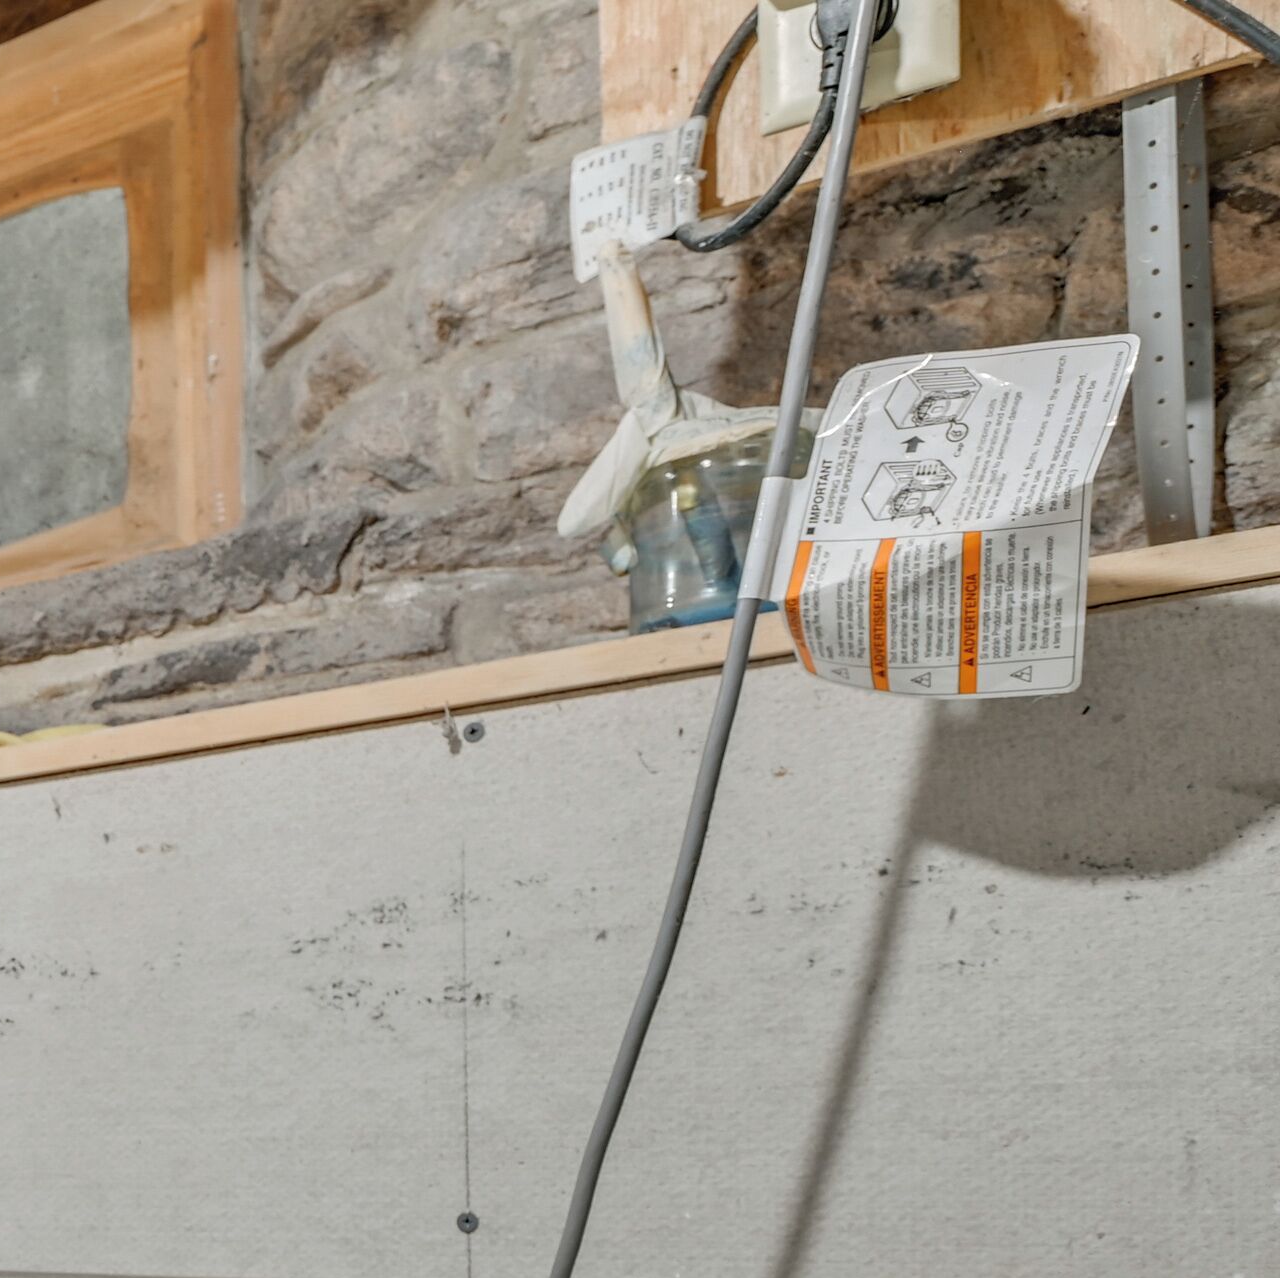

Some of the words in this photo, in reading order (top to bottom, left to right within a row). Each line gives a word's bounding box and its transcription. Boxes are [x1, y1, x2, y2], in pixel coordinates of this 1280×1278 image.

[1082, 391, 1093, 408] must
[1087, 381, 1096, 389] be
[994, 414, 1004, 426] and
[1017, 482, 1028, 493] the
[1034, 421, 1048, 446] braces
[1043, 404, 1054, 417] and
[1049, 388, 1060, 400] the
[1055, 355, 1067, 383] wrench
[1072, 411, 1087, 434] braces
[976, 421, 991, 452] shipping
[1067, 436, 1078, 448] and
[825, 480, 842, 517] SHIPPING
[841, 424, 853, 446] MUST
[1035, 476, 1051, 515] (Whenever
[1045, 464, 1055, 474] the
[1051, 425, 1069, 461] appliances
[1060, 451, 1072, 467] bolts
[809, 458, 832, 524] IMPORTANT
[834, 495, 848, 524] BEFORE
[841, 451, 858, 492] OPERATING
[851, 435, 861, 449] THE
[1052, 469, 1067, 498] shipping
[988, 500, 997, 510] the
[1024, 484, 1038, 505] future
[1049, 501, 1057, 511] the
[1022, 507, 1030, 516] for
[984, 548, 992, 581] advertencia
[873, 570, 884, 667] ADVERTISSEMENT
[964, 574, 977, 653] ADVERTENCIA
[1004, 593, 1015, 625] descargas
